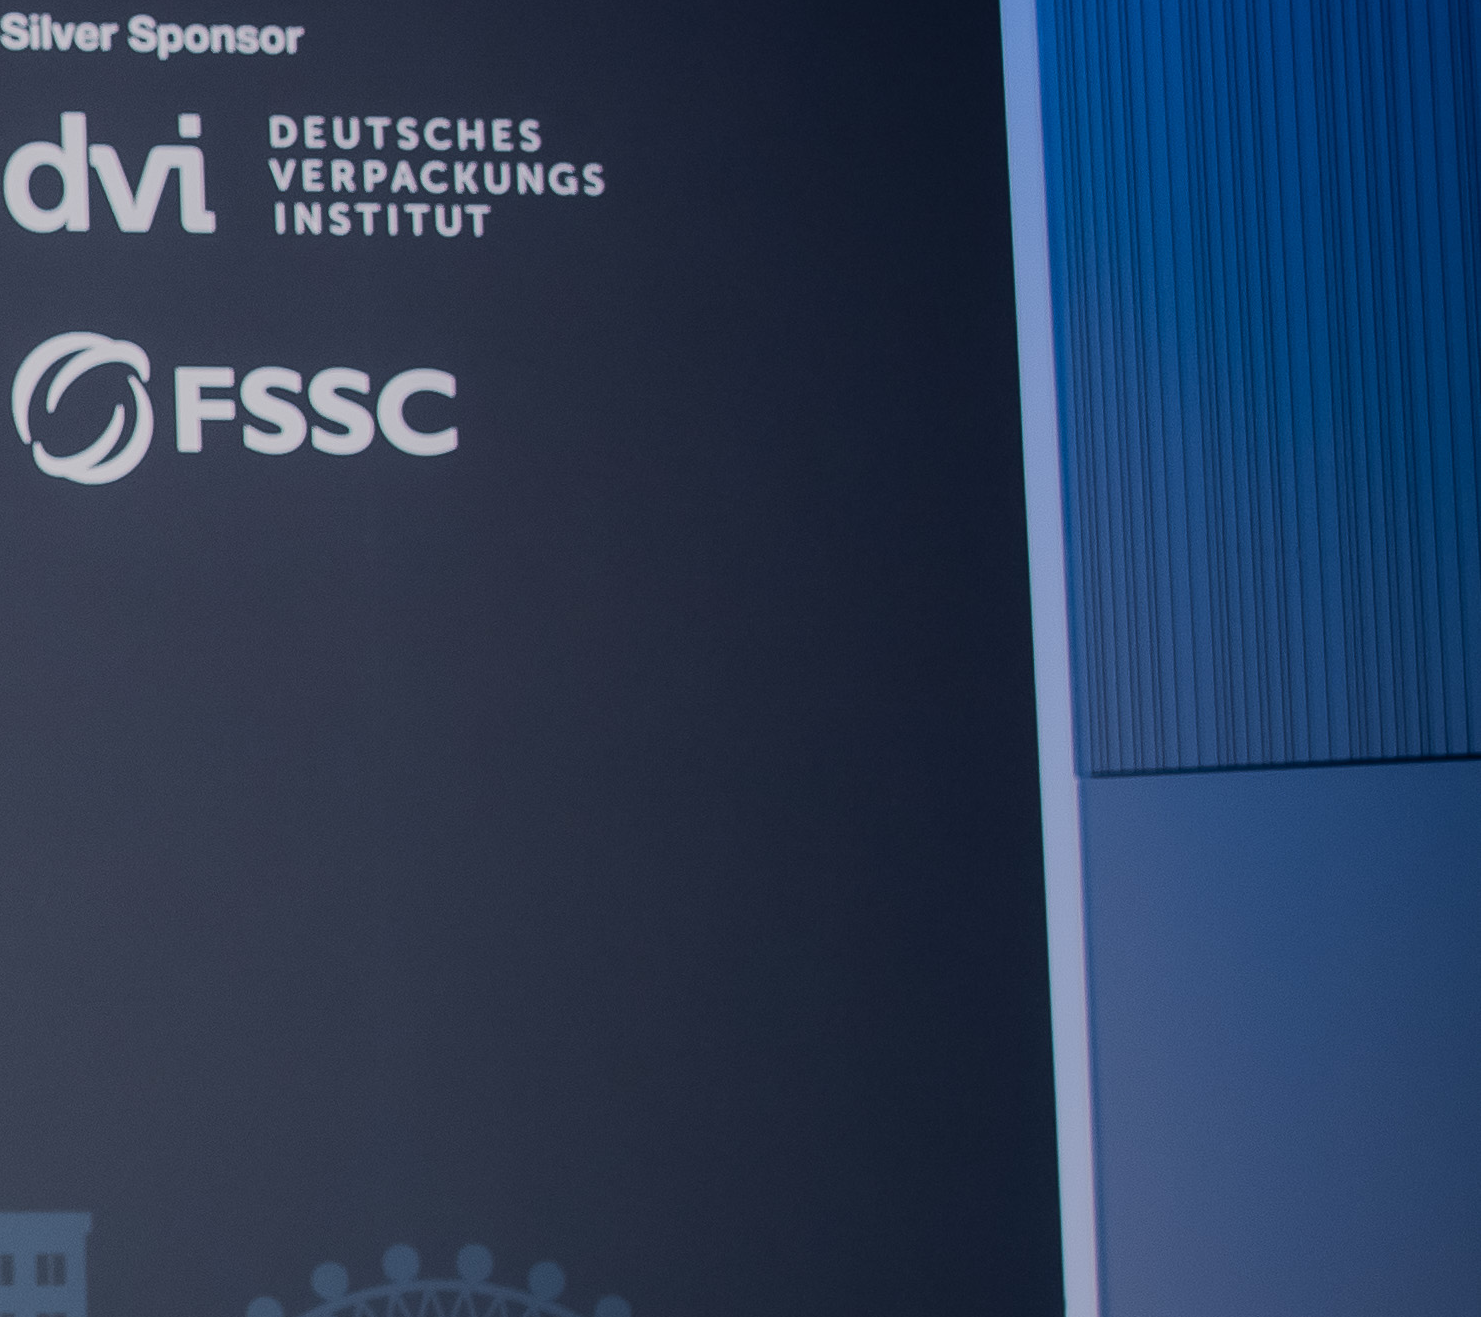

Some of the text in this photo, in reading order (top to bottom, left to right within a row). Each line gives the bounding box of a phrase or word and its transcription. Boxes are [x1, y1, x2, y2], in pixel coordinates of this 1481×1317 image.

[0, 12, 304, 60] Silver Sponsor
[269, 115, 541, 152] DEUTSCHES
[4, 112, 216, 233] dvi
[269, 159, 604, 196] VERPACKUNGS
[275, 202, 490, 237] INSTITUT
[175, 367, 458, 456] FSSC
